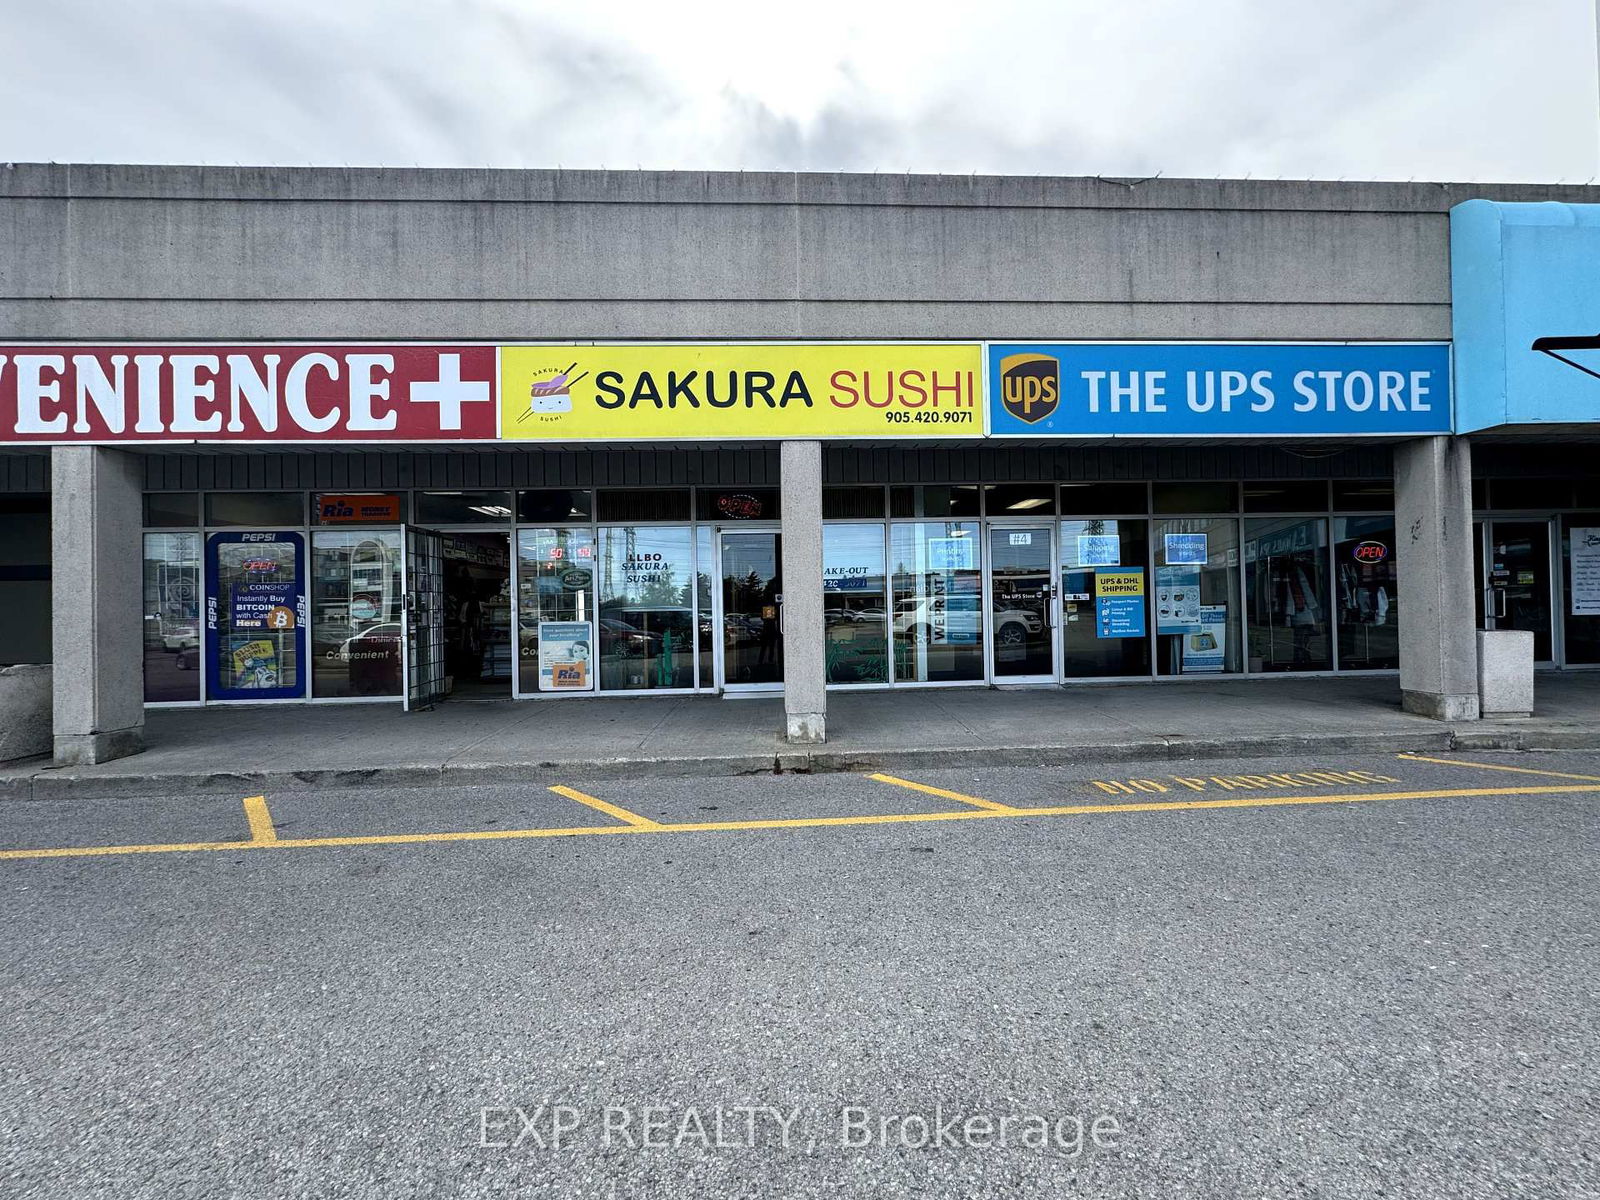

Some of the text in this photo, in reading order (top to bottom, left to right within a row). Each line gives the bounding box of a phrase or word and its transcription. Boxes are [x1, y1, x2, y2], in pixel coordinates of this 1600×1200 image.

[533, 368, 563, 376] SAKURA
[0, 352, 398, 433] ENIENCE
[595, 370, 973, 409] SAKURA SUSHI
[1005, 369, 1056, 413] ups
[1081, 370, 1431, 412] THE UPS STORE
[885, 412, 973, 423] 905.420.9071
[322, 500, 353, 517] Ria
[242, 533, 276, 541] PEPSI
[1014, 533, 1027, 543] #4
[1169, 542, 1204, 550] Shredding
[1356, 546, 1384, 558] OPEN
[242, 561, 277, 571] OPEN
[627, 575, 661, 583] SUSHI
[1102, 585, 1138, 593] SHIPPING
[237, 595, 285, 603] Instantly Buy
[208, 597, 217, 629] PEPSI
[297, 595, 305, 627] PEPSI
[326, 650, 390, 660] Convenient
[558, 666, 580, 679] Ria
[1088, 771, 1402, 794] NO PARKING
